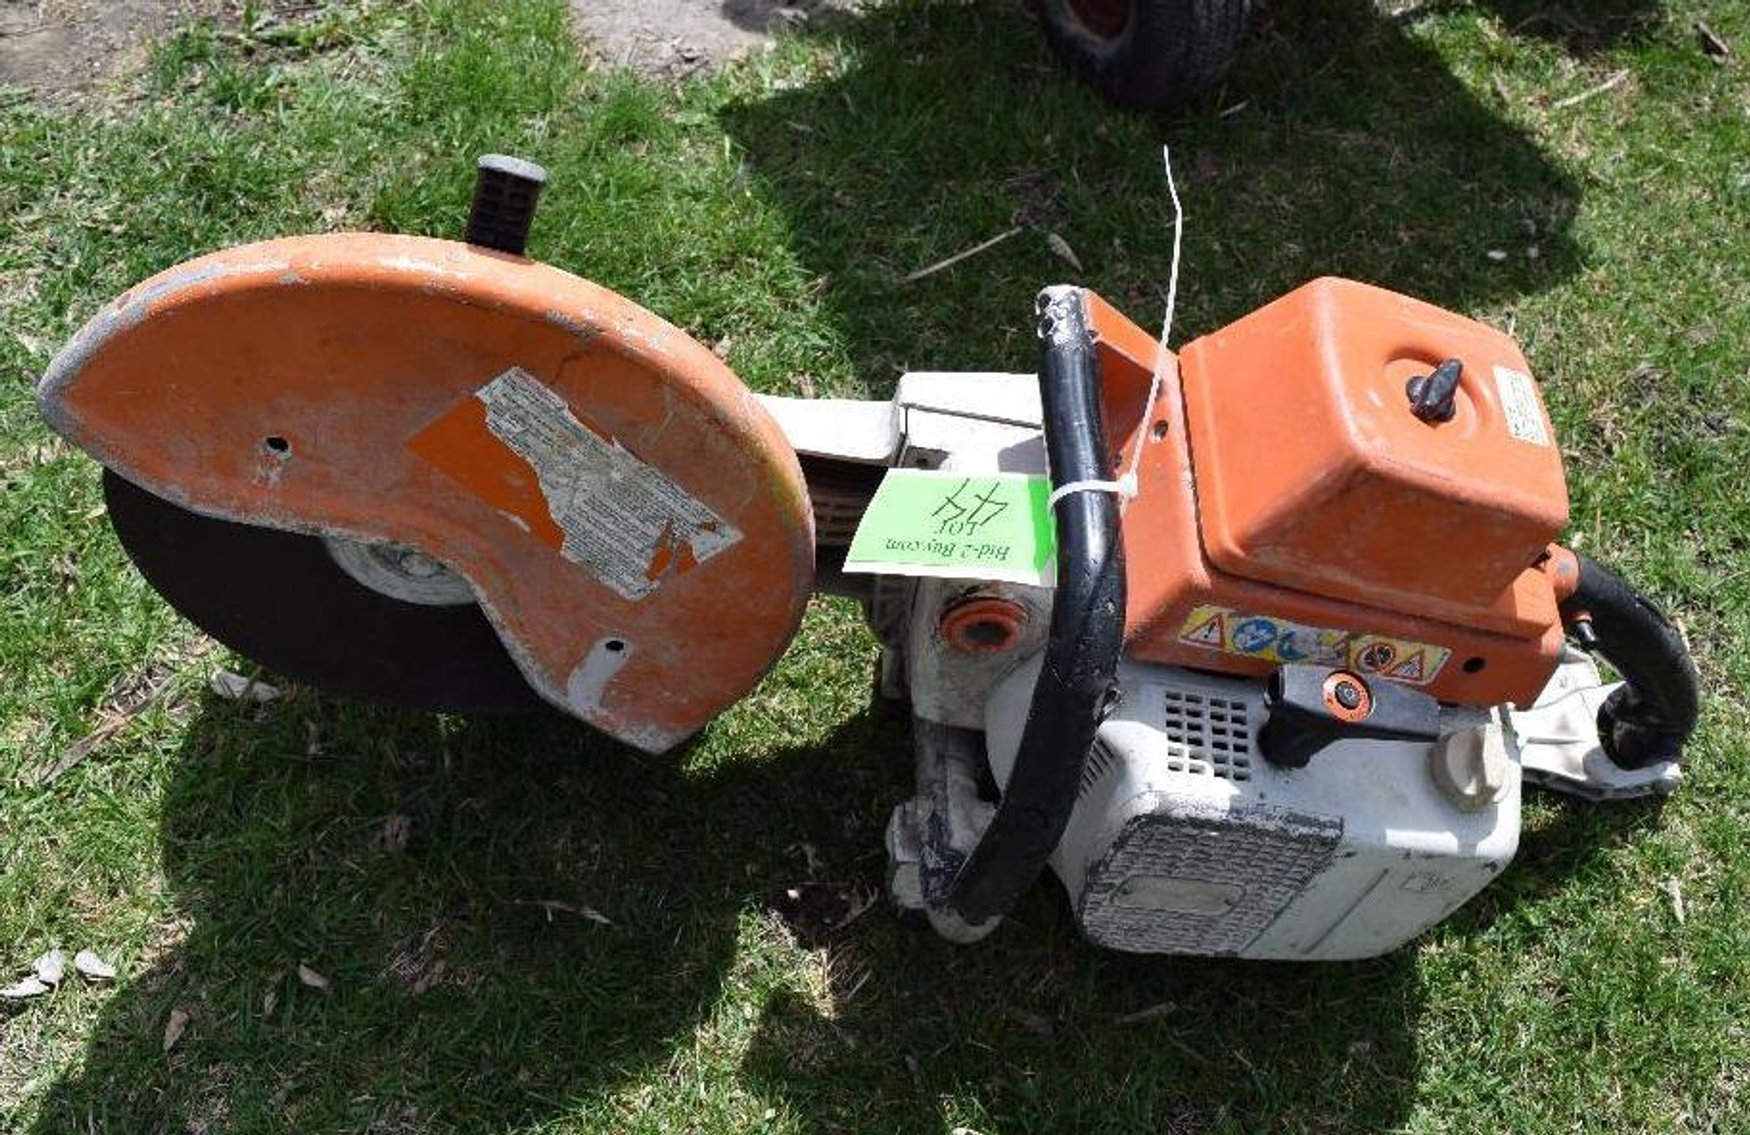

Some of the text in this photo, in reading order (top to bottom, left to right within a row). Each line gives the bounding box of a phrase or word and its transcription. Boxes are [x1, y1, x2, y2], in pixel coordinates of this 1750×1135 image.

[931, 477, 1009, 527] 44
[934, 521, 978, 536] LOT
[885, 537, 1010, 561] Bid-2 Buy.com
